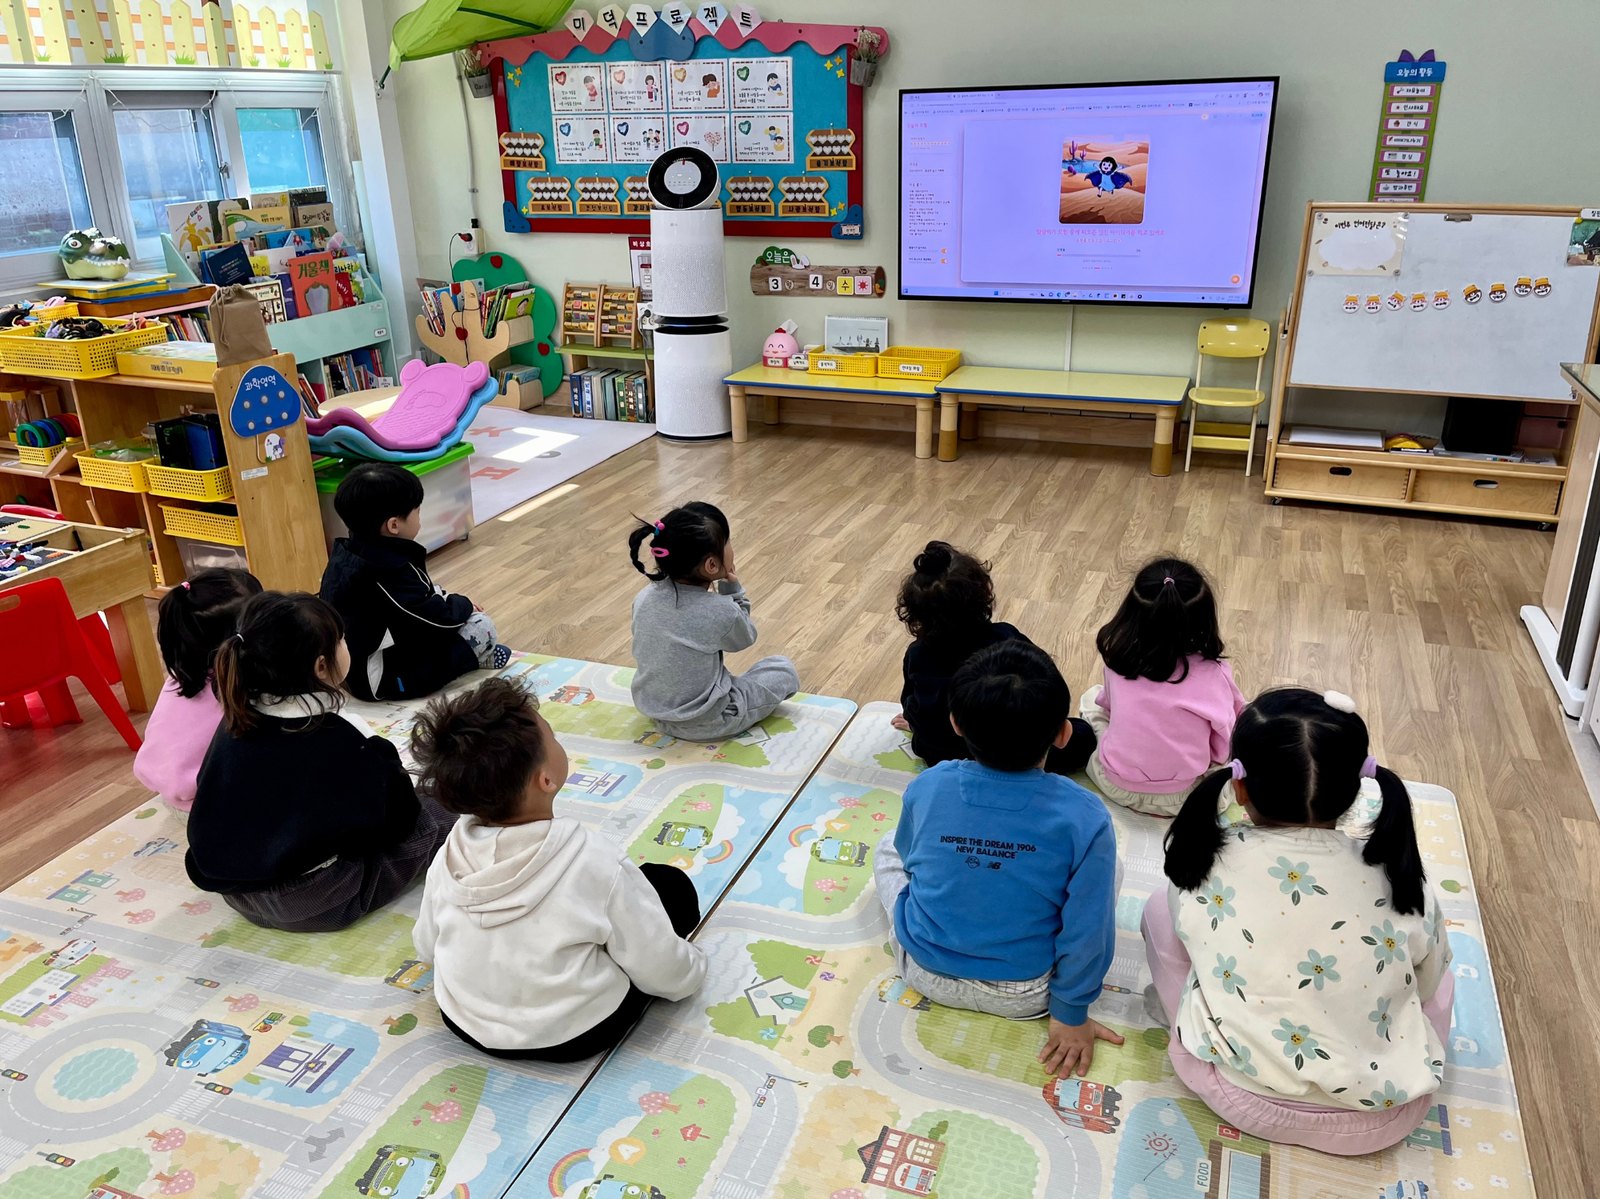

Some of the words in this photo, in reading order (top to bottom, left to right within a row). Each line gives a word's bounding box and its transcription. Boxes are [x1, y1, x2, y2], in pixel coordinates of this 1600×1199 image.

[1396, 67, 1418, 77] 오늘의
[1418, 66, 1433, 77] 활동
[766, 251, 791, 264] 오늘은
[771, 279, 779, 289] 3
[812, 276, 819, 287] 4
[841, 279, 850, 291] 수
[245, 375, 276, 391] 과학영역
[940, 835, 968, 845] INSPIRE
[969, 838, 983, 847] THE
[985, 840, 1014, 850] DREAM
[1016, 843, 1037, 852] 1906
[956, 845, 975, 854] NEW
[976, 848, 1016, 859] BALANCE
[1197, 1162, 1209, 1187] FOOD
